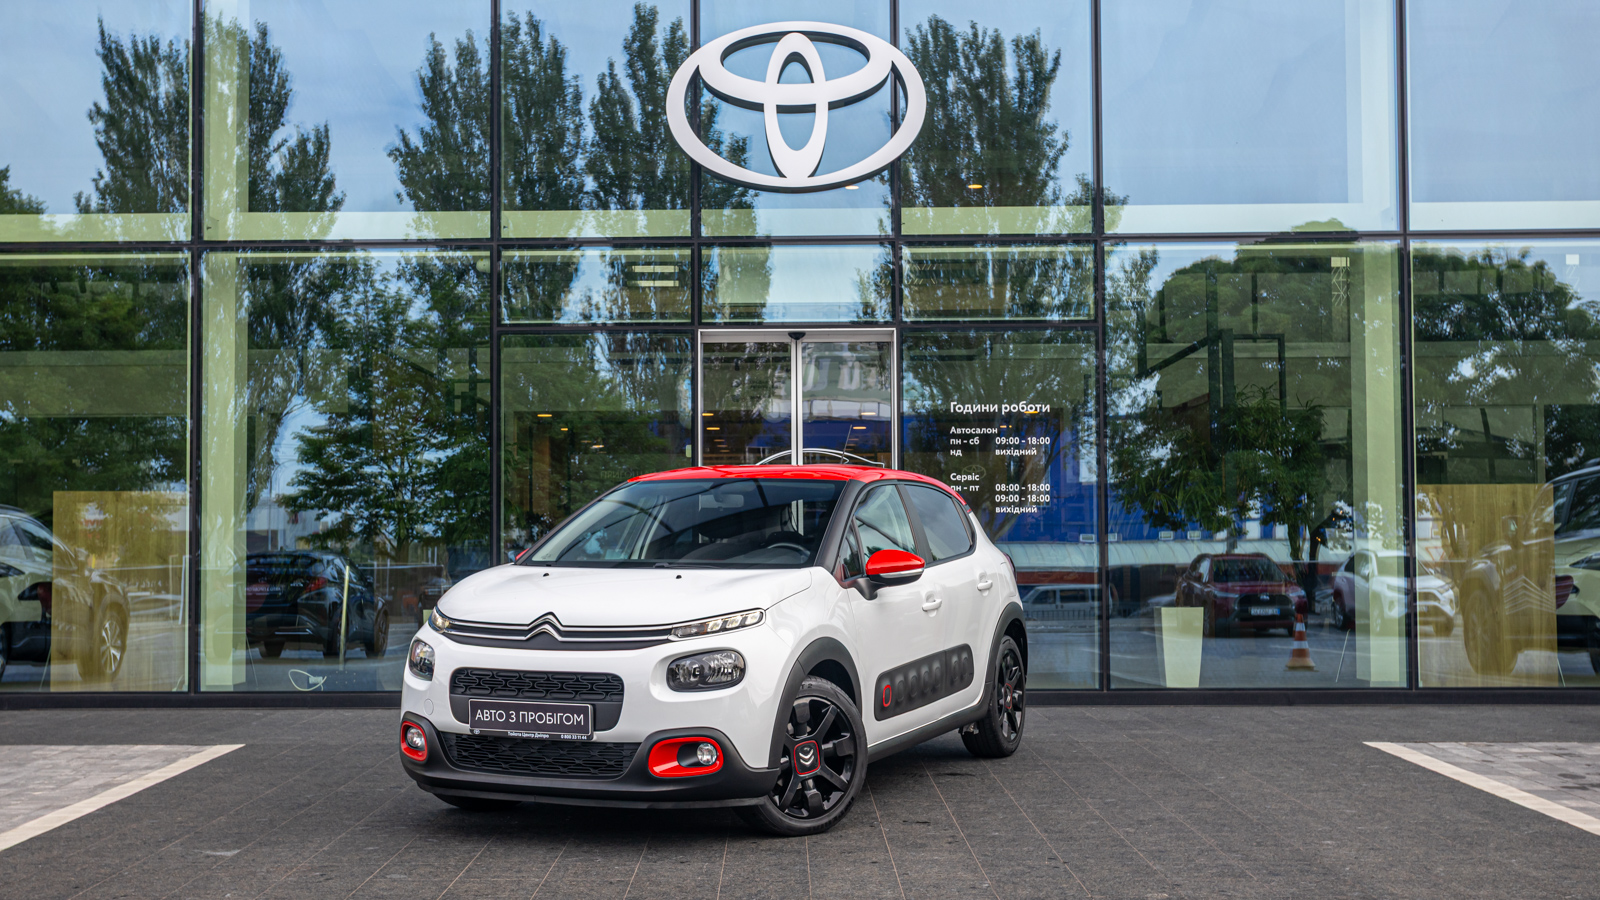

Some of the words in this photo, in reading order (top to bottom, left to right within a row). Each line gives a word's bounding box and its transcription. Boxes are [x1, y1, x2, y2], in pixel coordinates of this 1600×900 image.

[950, 401, 998, 415] Години
[1001, 400, 1050, 415] роботи
[950, 426, 998, 434] Автосалон
[969, 437, 980, 445] сб
[995, 437, 1020, 445] 09:00
[1027, 437, 1050, 445] 18:00
[995, 447, 1037, 456] вихідний
[950, 473, 980, 482] Сервіс
[995, 484, 1020, 492] 08:00
[1027, 484, 1050, 492] 18:00
[995, 506, 1038, 514] вихідний
[475, 709, 506, 722] АВТО
[508, 711, 516, 723] З
[519, 711, 584, 726] ПРОБІГОМ
